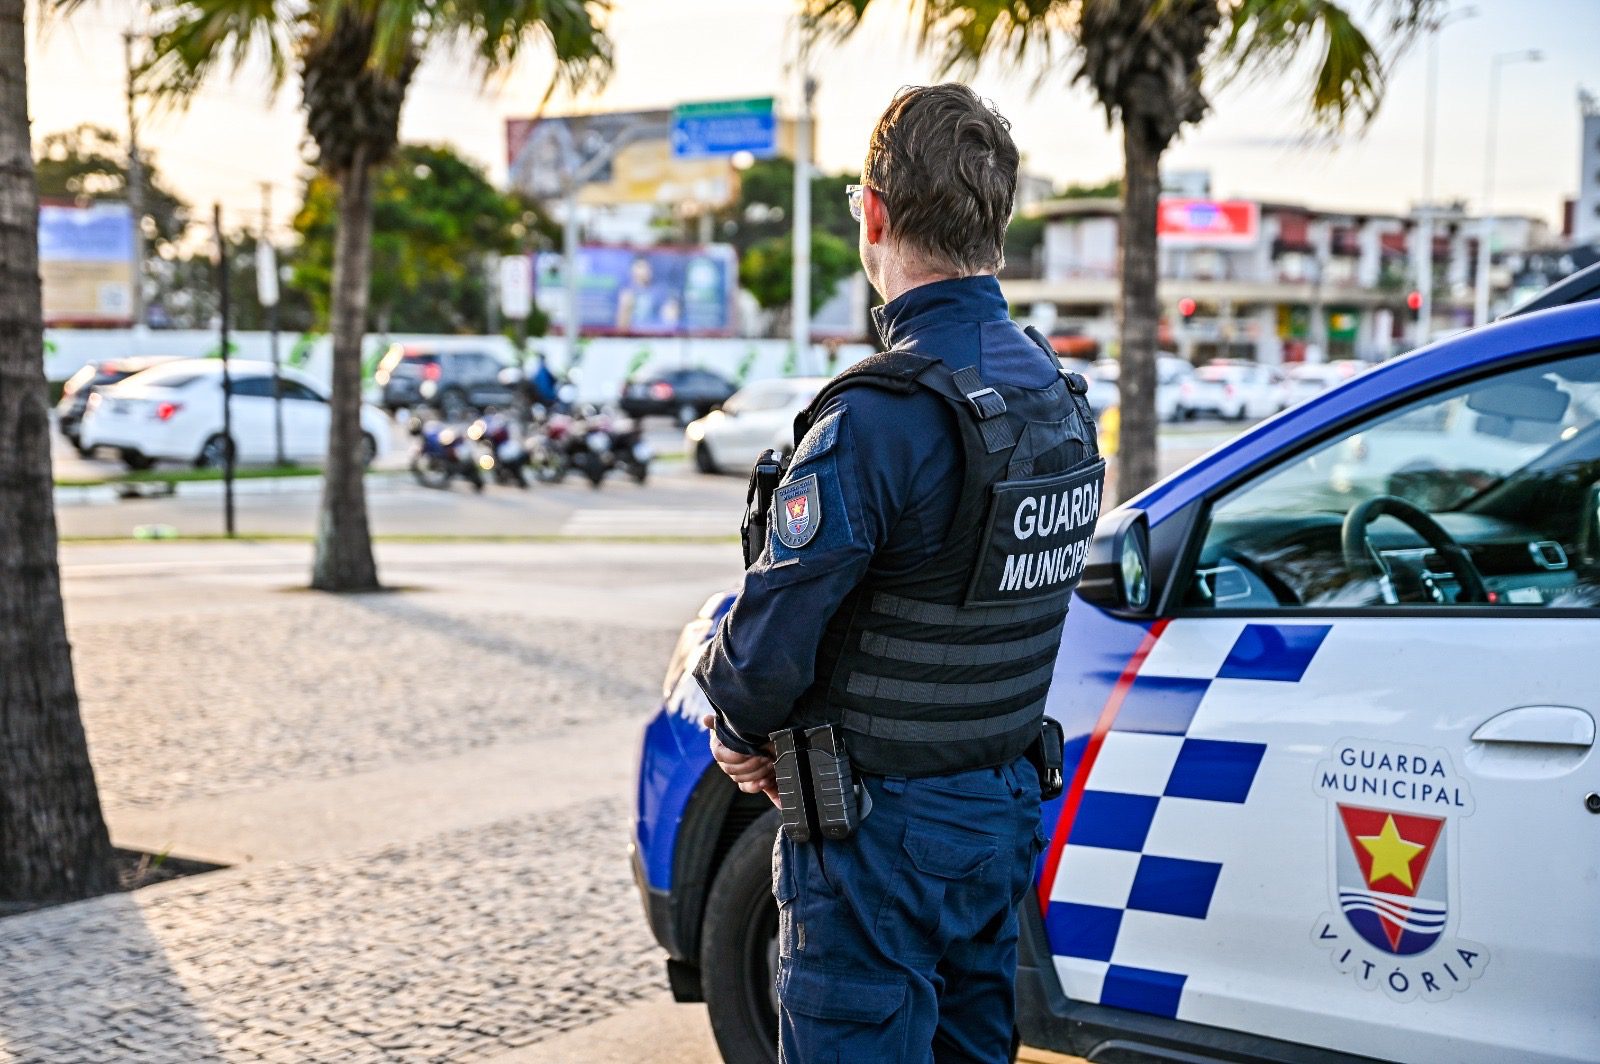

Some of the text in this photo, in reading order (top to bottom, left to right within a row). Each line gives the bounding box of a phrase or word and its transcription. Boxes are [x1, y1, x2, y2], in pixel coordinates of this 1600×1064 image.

[1014, 480, 1098, 539] GUARDA
[1341, 748, 1445, 778] GUARDA
[1321, 772, 1464, 806] MUNICIPAL
[1320, 923, 1478, 992] VITÓRIA
